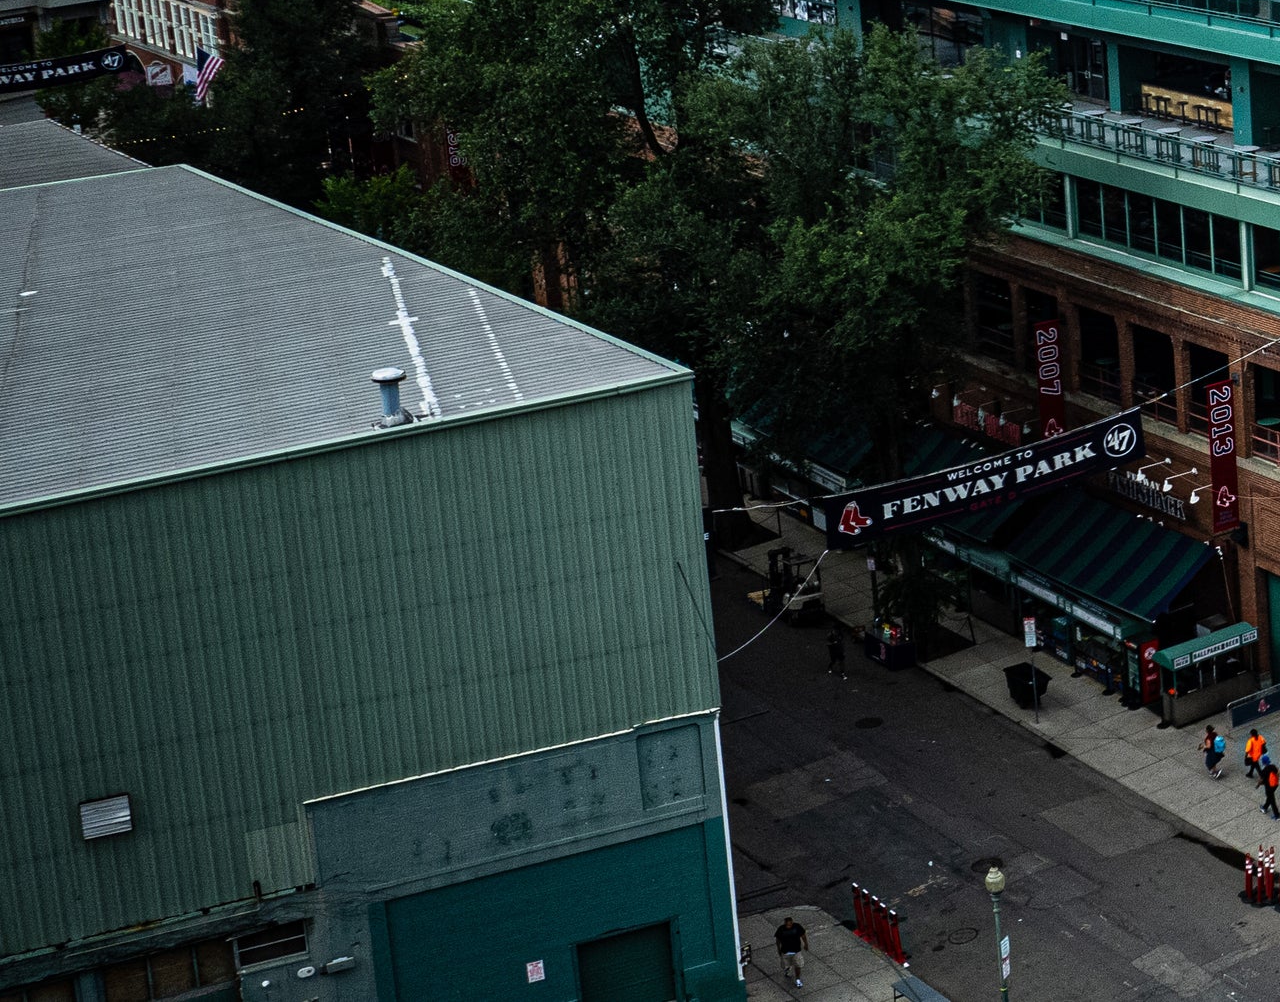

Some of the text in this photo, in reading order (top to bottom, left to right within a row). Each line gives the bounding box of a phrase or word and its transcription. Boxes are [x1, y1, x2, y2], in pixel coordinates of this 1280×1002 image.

[0, 61, 97, 85] WAY PARK
[1, 63, 38, 73] ELCOME
[1036, 327, 1061, 395] 2007
[1209, 385, 1234, 457] 2013
[882, 441, 1098, 520] FENWAY PARK
[947, 449, 1034, 481] WELCOME TO
